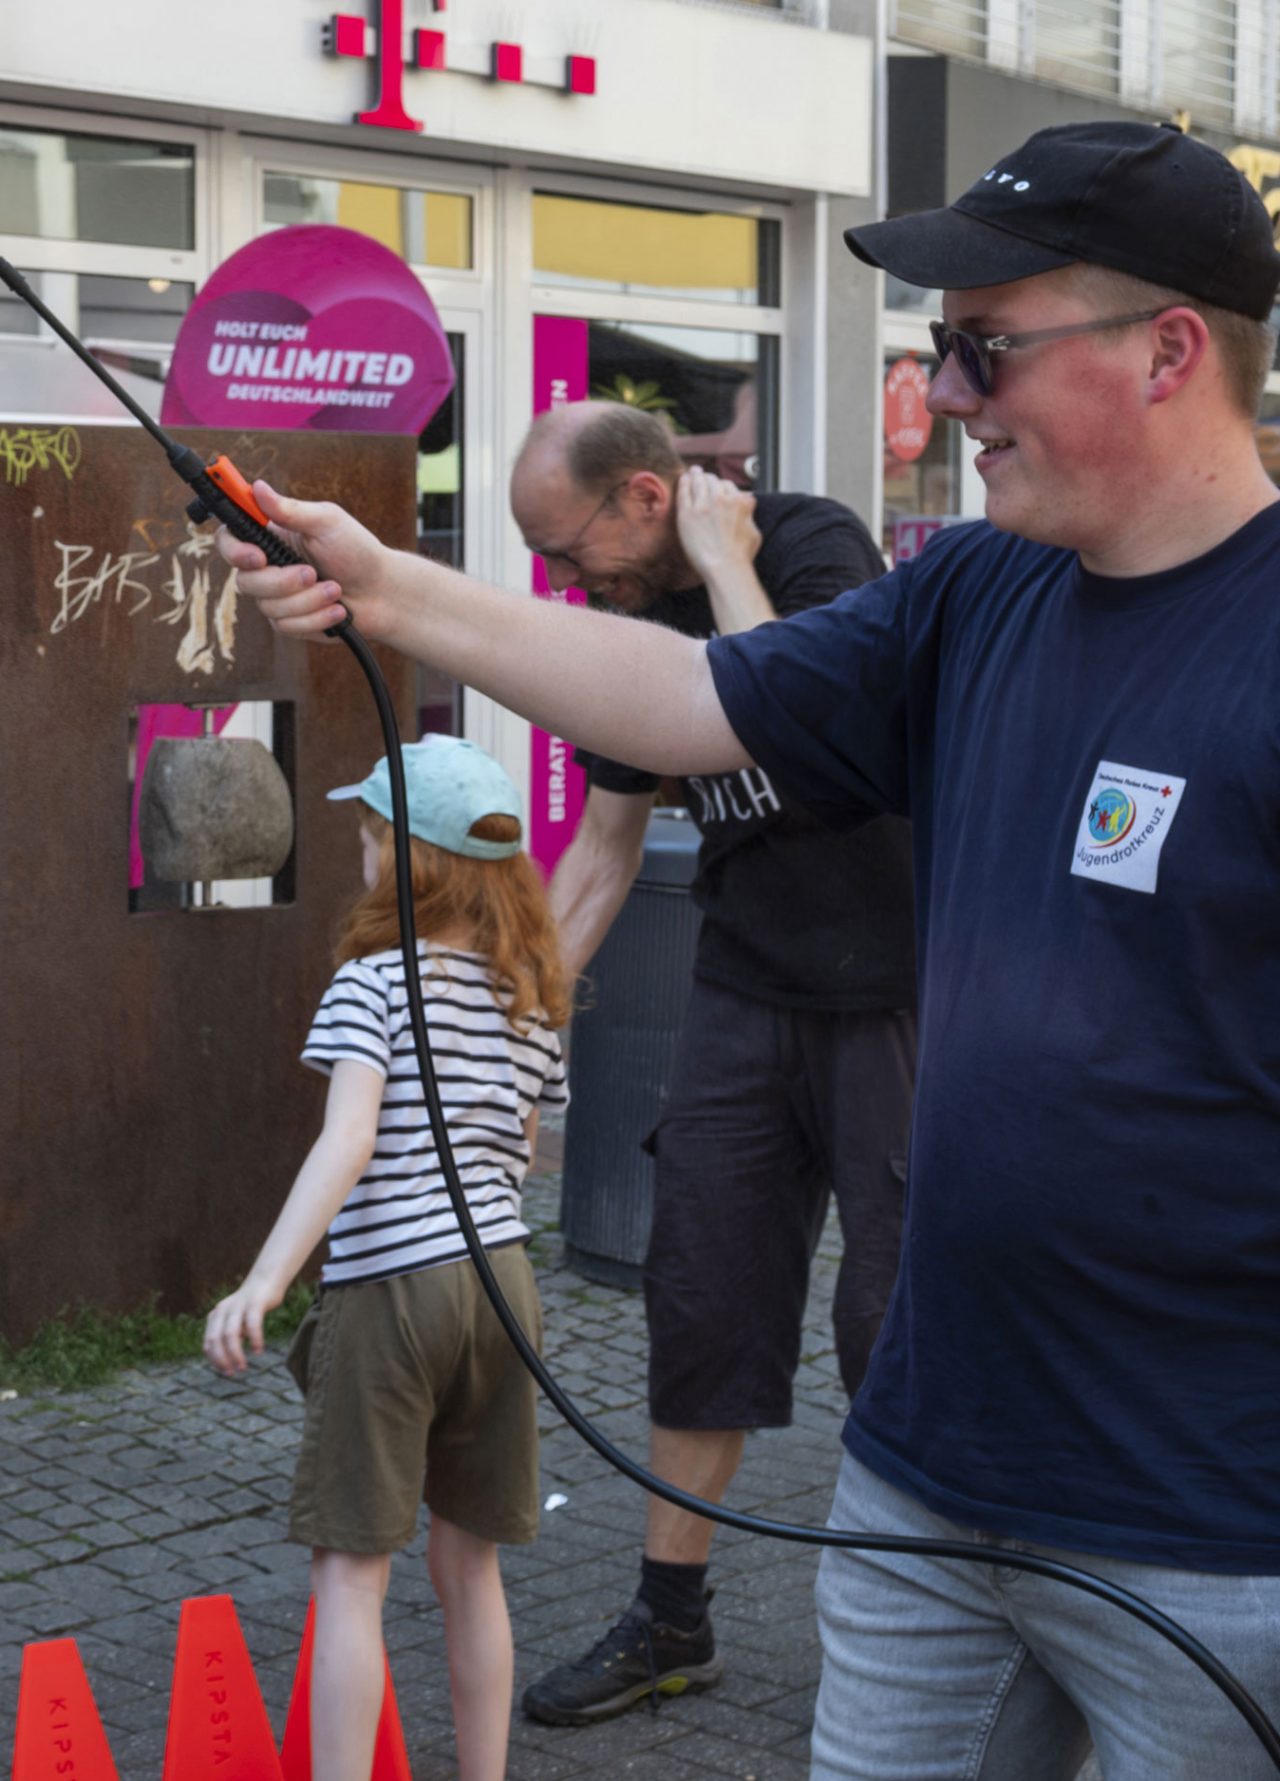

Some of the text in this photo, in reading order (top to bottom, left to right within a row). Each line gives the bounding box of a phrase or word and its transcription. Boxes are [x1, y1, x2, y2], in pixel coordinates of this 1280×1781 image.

[214, 320, 308, 341] HOLT EUCH
[207, 343, 415, 387] UNLIMITED
[226, 383, 395, 409] DEUTSCHLANDWEIT
[1077, 806, 1165, 867] Jugendrotkreuz
[205, 1650, 232, 1766] KIPSTA
[48, 1698, 76, 1781] KIPS
